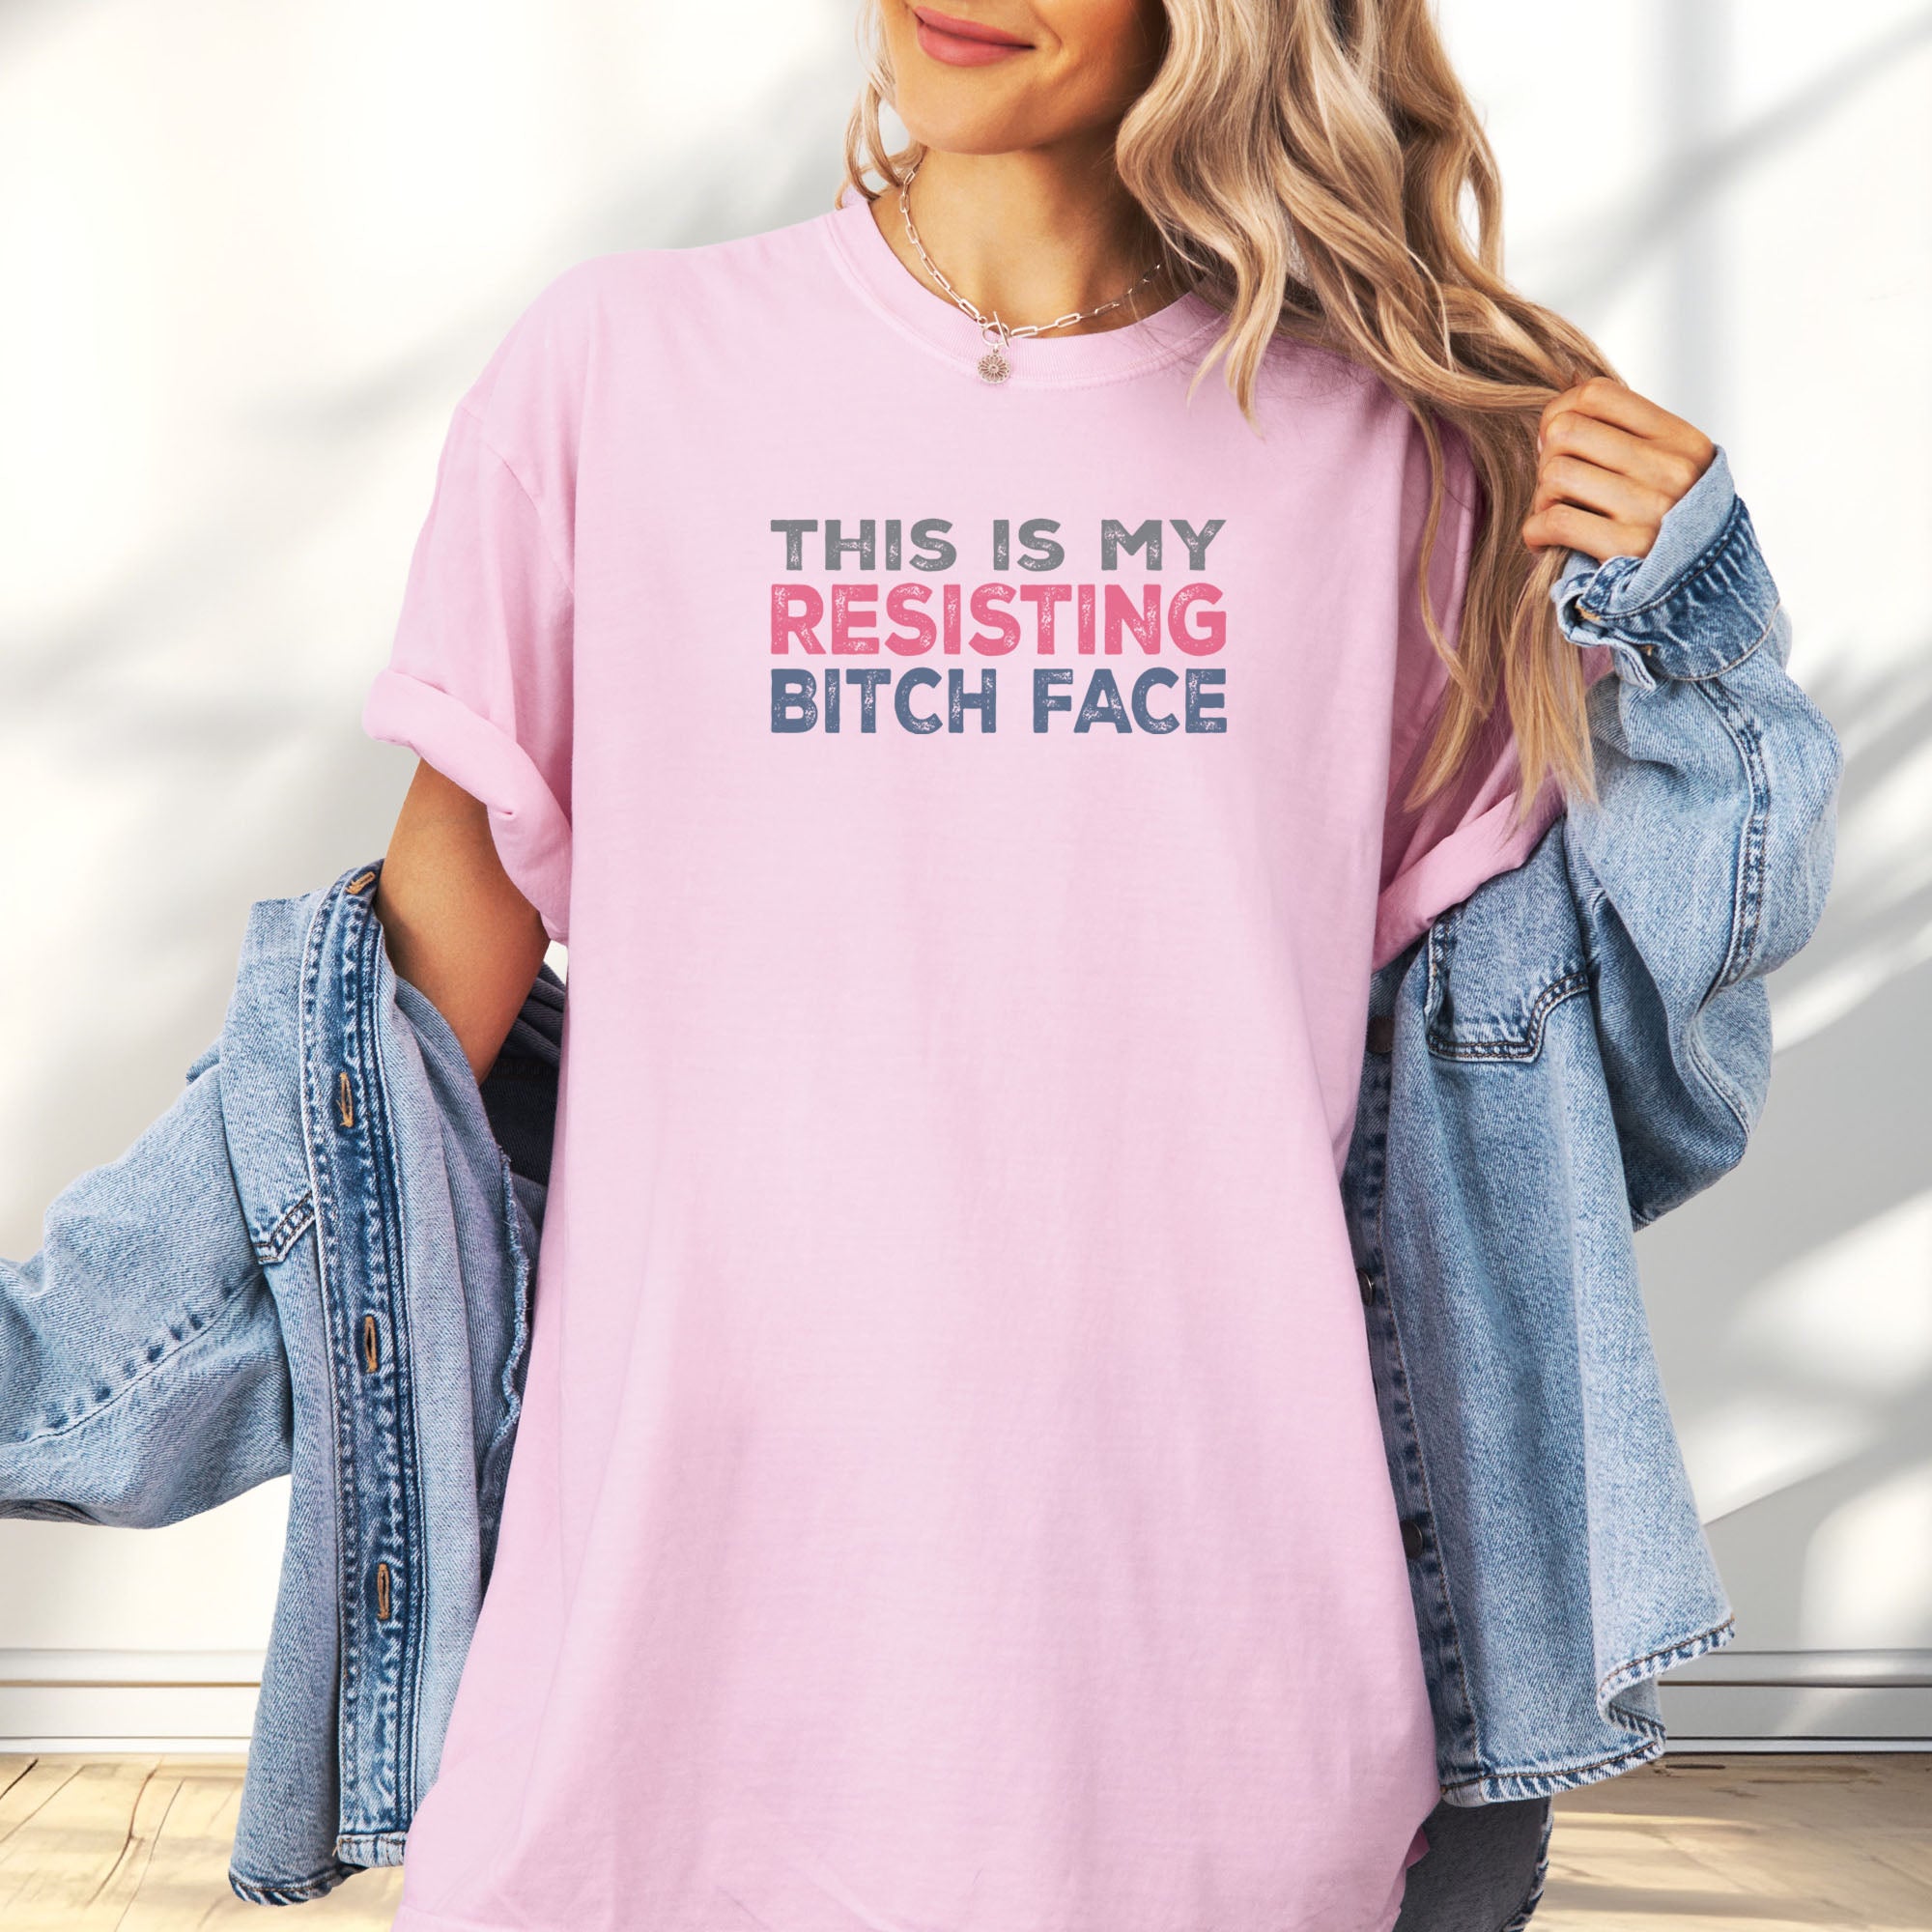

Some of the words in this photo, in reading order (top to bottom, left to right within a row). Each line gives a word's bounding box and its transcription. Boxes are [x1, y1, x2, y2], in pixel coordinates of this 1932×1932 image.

[770, 518, 957, 572] THIS
[992, 518, 1065, 572] IS
[1100, 519, 1227, 571] MY
[770, 582, 1227, 657] RESISTING
[770, 667, 997, 734] BITCH
[1032, 667, 1228, 734] FACE
